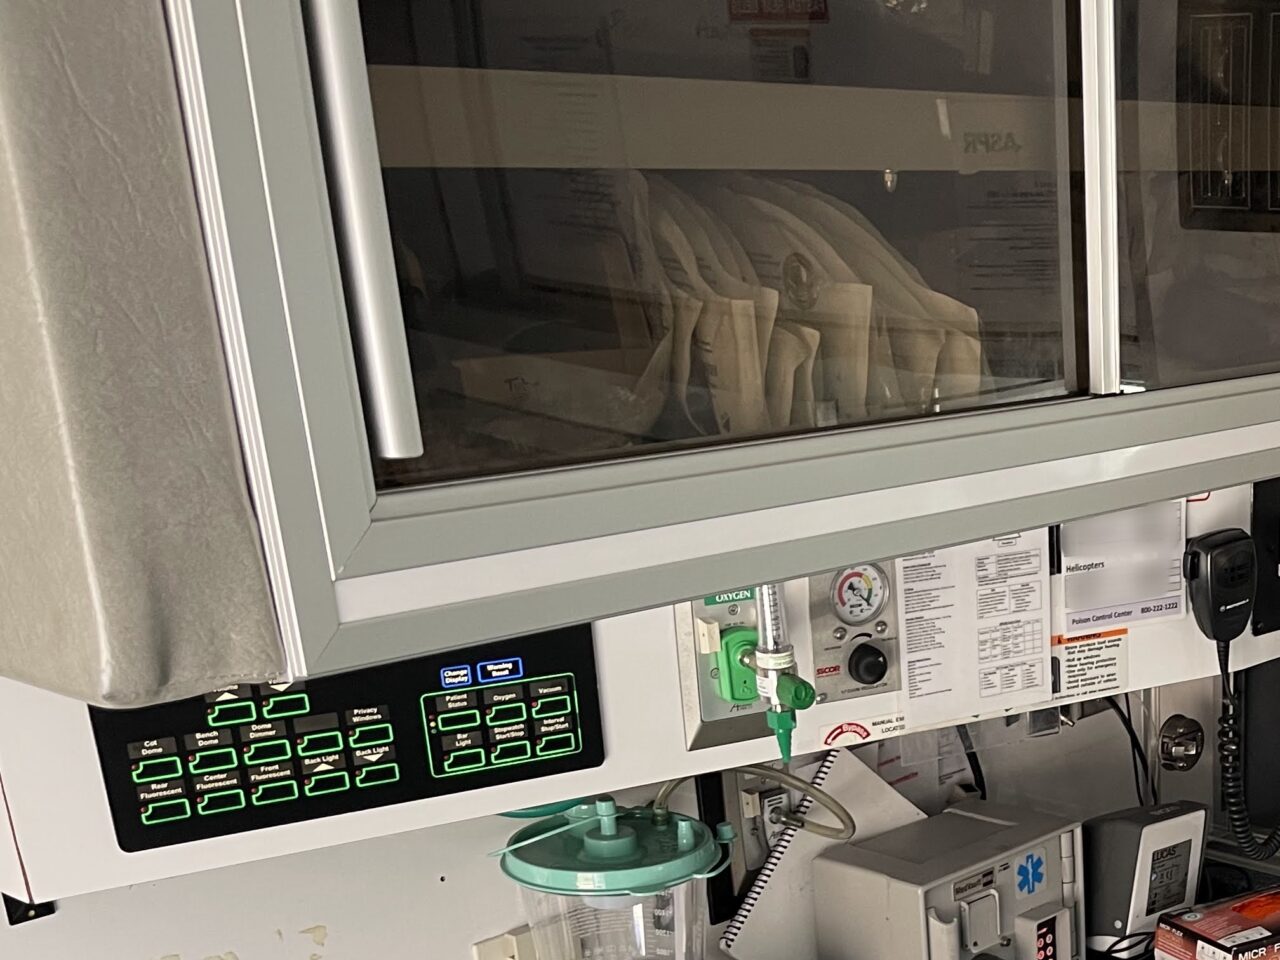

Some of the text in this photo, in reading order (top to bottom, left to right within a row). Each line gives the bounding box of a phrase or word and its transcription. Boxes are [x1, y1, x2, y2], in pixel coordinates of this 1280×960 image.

[1065, 560, 1105, 573] Helicopters
[715, 590, 751, 602] OXYGEN
[1072, 602, 1178, 625] Poison Control Center 800-222-1222
[487, 662, 512, 671] Warning
[444, 669, 467, 677] Change
[492, 669, 509, 677] Reset
[446, 676, 468, 684] Display
[538, 686, 562, 694] Vacuum
[493, 693, 516, 701] Oxygen
[354, 707, 377, 715] Privacy
[353, 714, 382, 722] Windows
[251, 722, 272, 730] Dome
[494, 724, 524, 733] Stopwatch
[196, 731, 218, 739] Bench
[250, 729, 276, 738] Dimmer
[496, 730, 524, 740] Start/Stop
[144, 740, 157, 748] Cot
[198, 737, 218, 745] Dome
[456, 739, 471, 747] Light
[142, 746, 162, 755] Dome
[356, 745, 389, 756] Back Light
[305, 754, 339, 765] Back Light
[260, 764, 279, 772] Front
[204, 773, 227, 781] Center
[251, 770, 291, 781] Fluorescent
[151, 782, 168, 790] Rear
[197, 778, 237, 790] Fluorescent
[140, 787, 182, 800] Fluorescent
[1153, 847, 1176, 860] LUCAS
